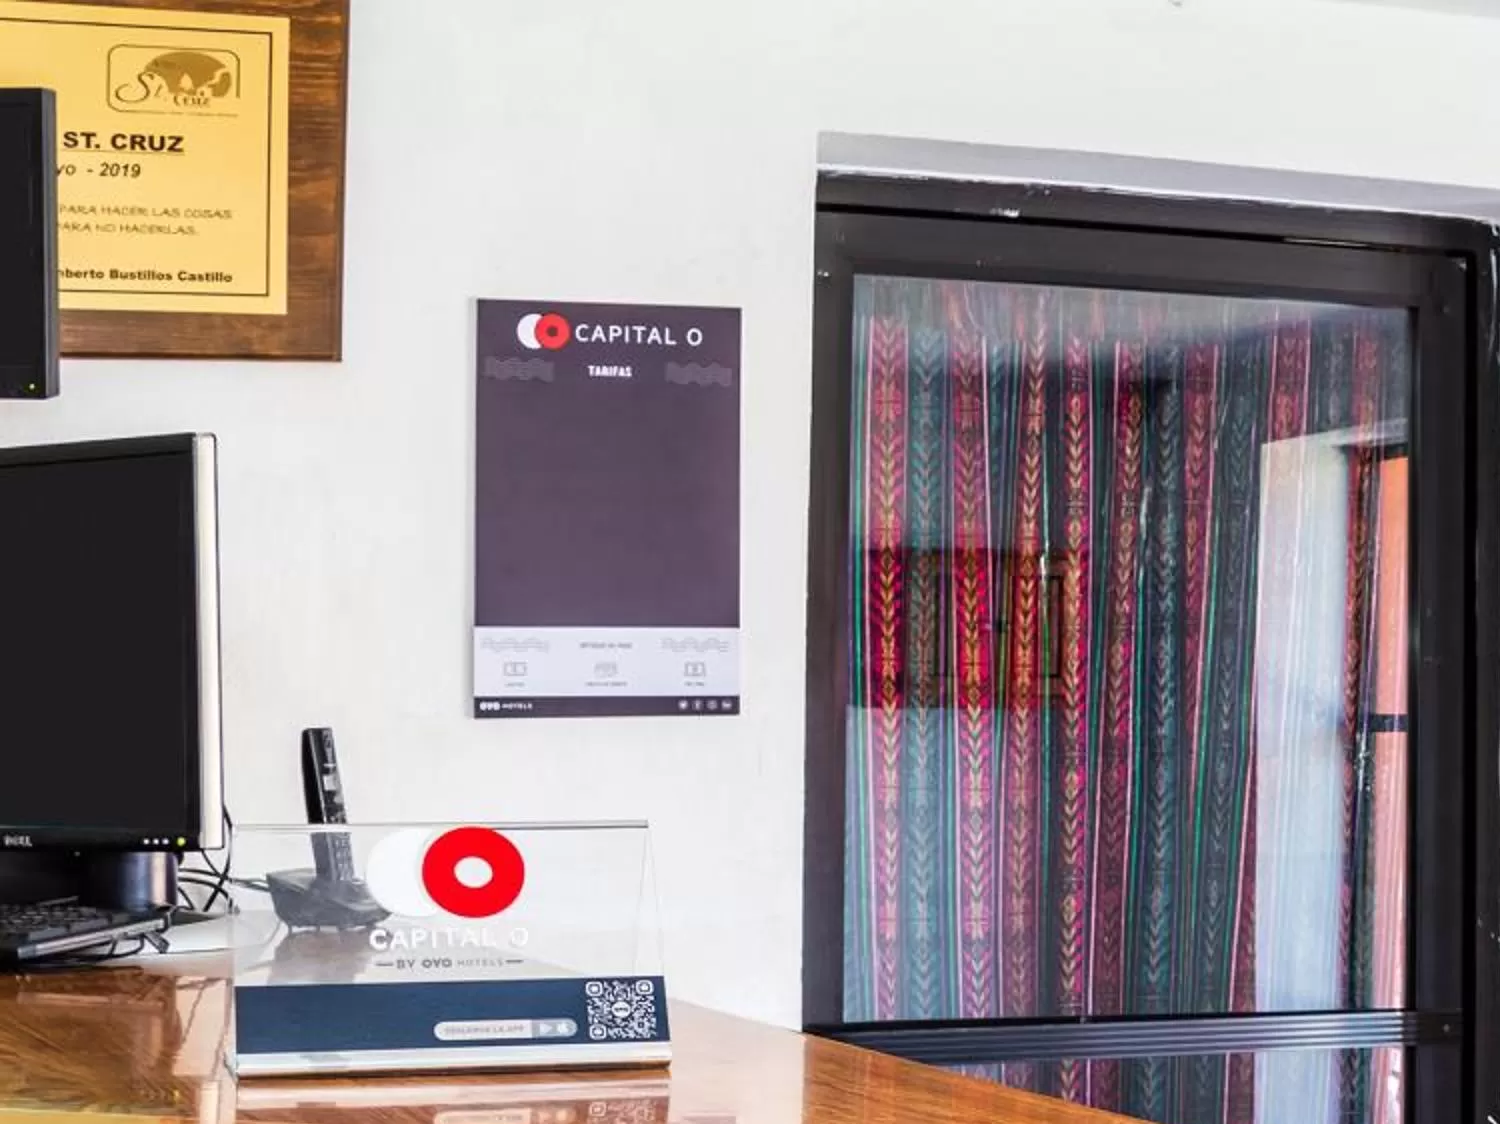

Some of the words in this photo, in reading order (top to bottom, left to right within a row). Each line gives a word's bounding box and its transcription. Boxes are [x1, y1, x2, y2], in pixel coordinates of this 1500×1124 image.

[63, 131, 101, 149] ST.
[111, 133, 185, 152] CRUZ
[99, 162, 142, 178] 2019
[152, 207, 180, 217] LAS
[184, 208, 233, 219] COSAS
[58, 267, 105, 280] berto
[109, 268, 172, 282] Bustillos
[177, 271, 233, 283] Castillo
[575, 323, 677, 345] CAPITAL
[686, 327, 703, 347] O
[587, 365, 632, 378] TARIFAS
[369, 927, 497, 950] CAPITAL
[510, 927, 529, 946] O
[396, 959, 415, 970] BY
